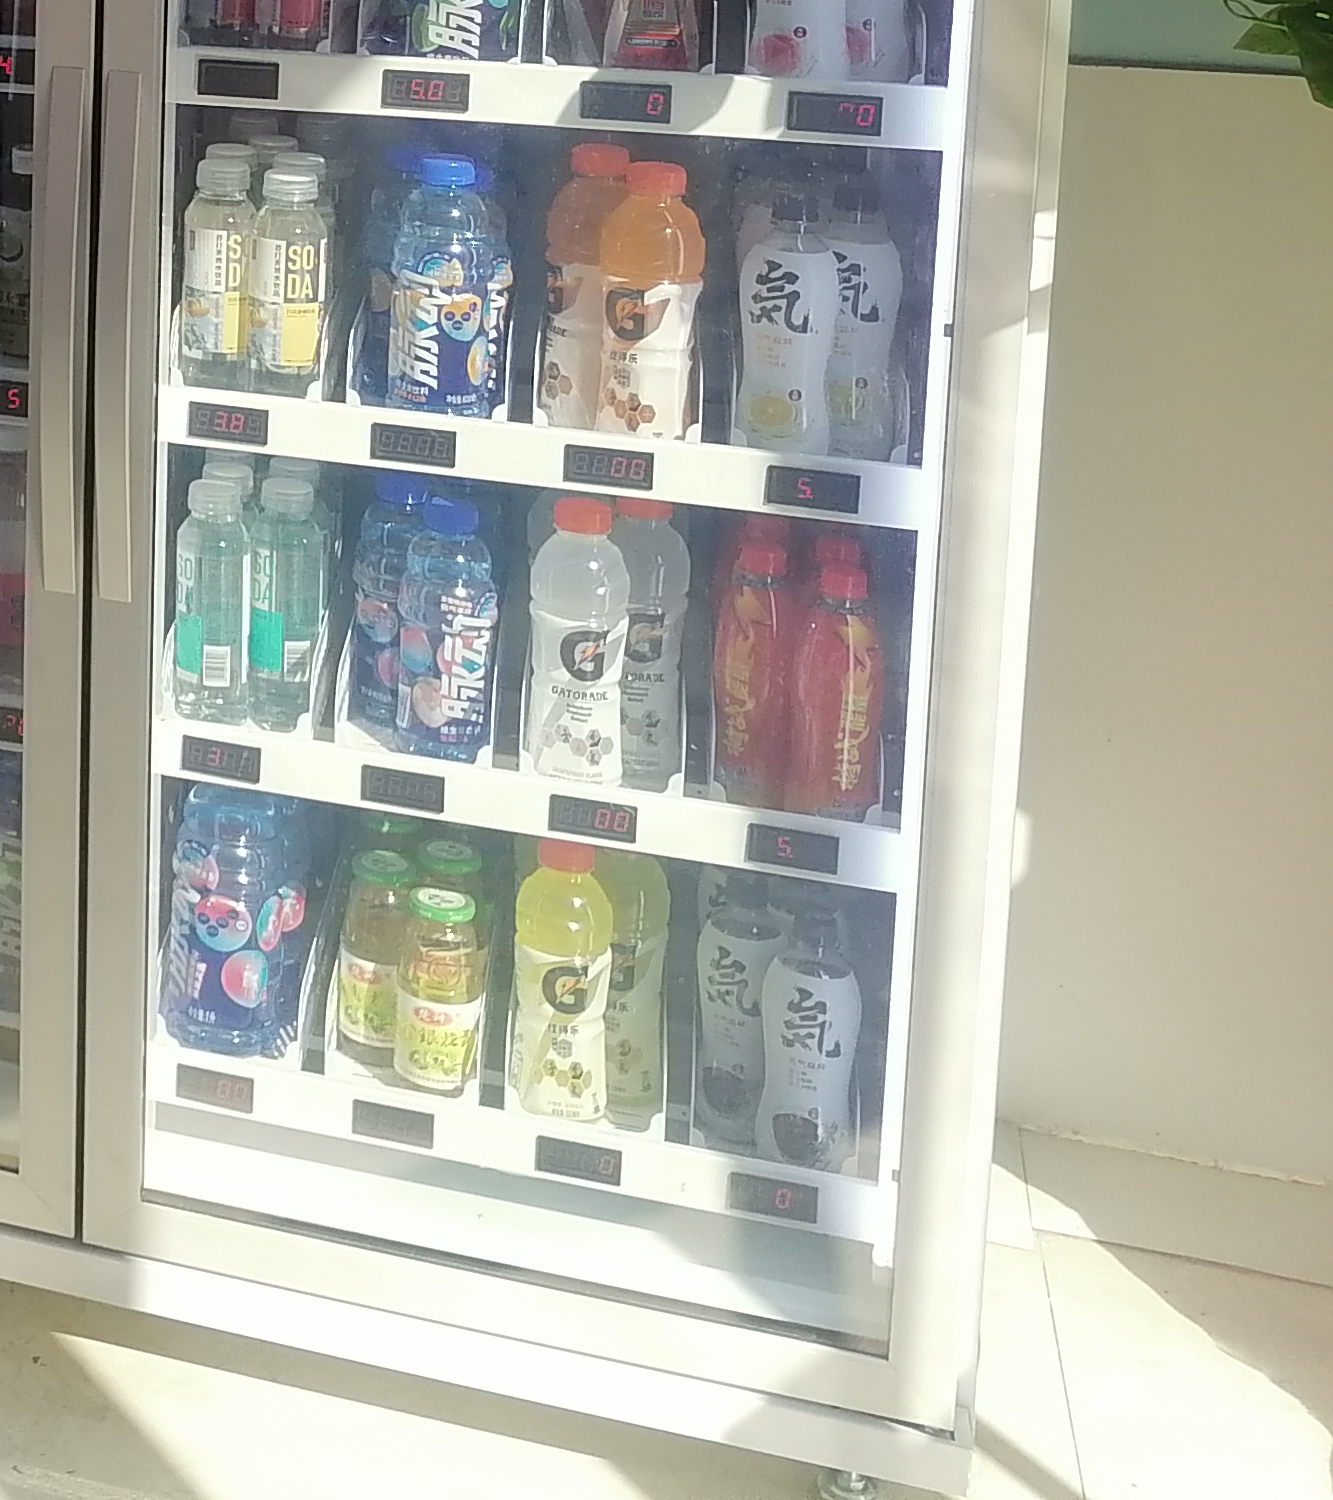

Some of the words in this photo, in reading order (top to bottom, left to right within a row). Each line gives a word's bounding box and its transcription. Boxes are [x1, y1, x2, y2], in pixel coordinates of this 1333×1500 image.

[287, 245, 315, 271] SO
[286, 273, 313, 298] DA
[551, 685, 608, 702] GATORADE
